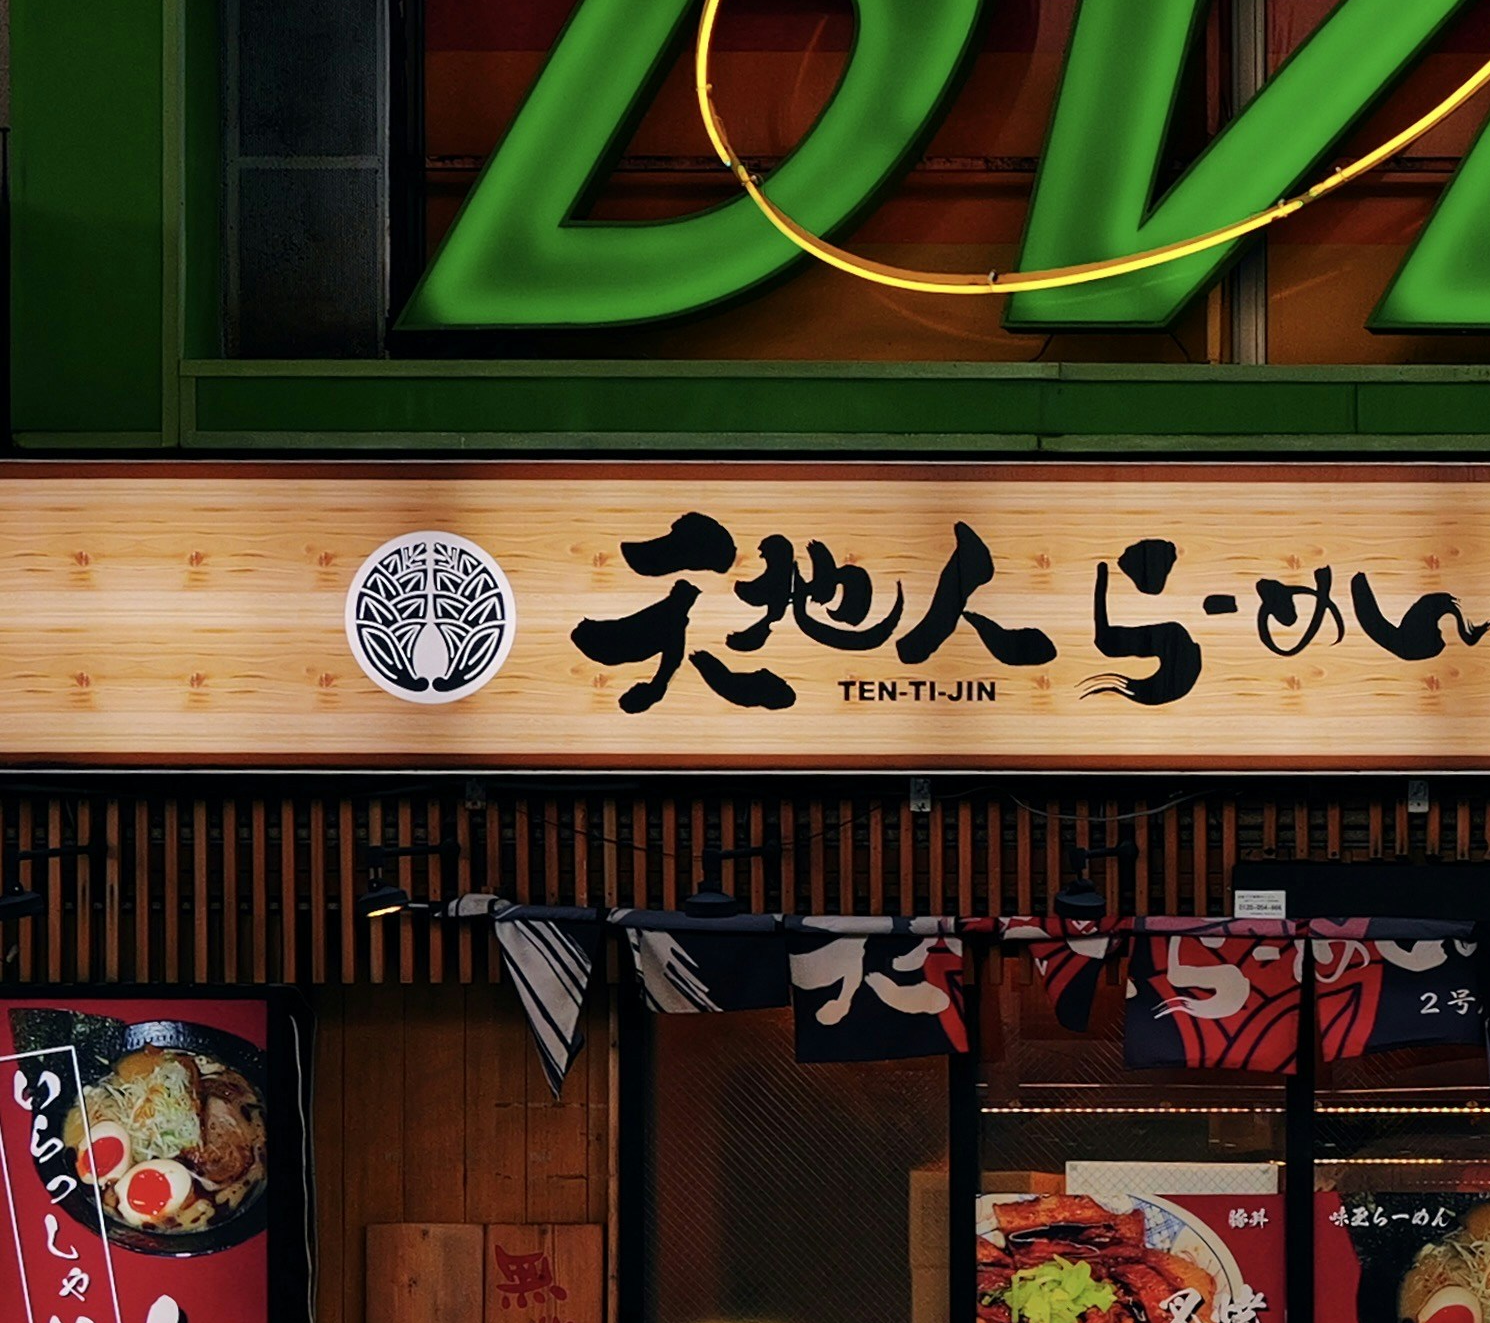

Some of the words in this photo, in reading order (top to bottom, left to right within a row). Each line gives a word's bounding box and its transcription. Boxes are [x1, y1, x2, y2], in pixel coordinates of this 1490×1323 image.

[571, 512, 1057, 714] 天地人
[838, 681, 997, 703] TEN-TI-JIN
[1419, 990, 1484, 1016] 2号
